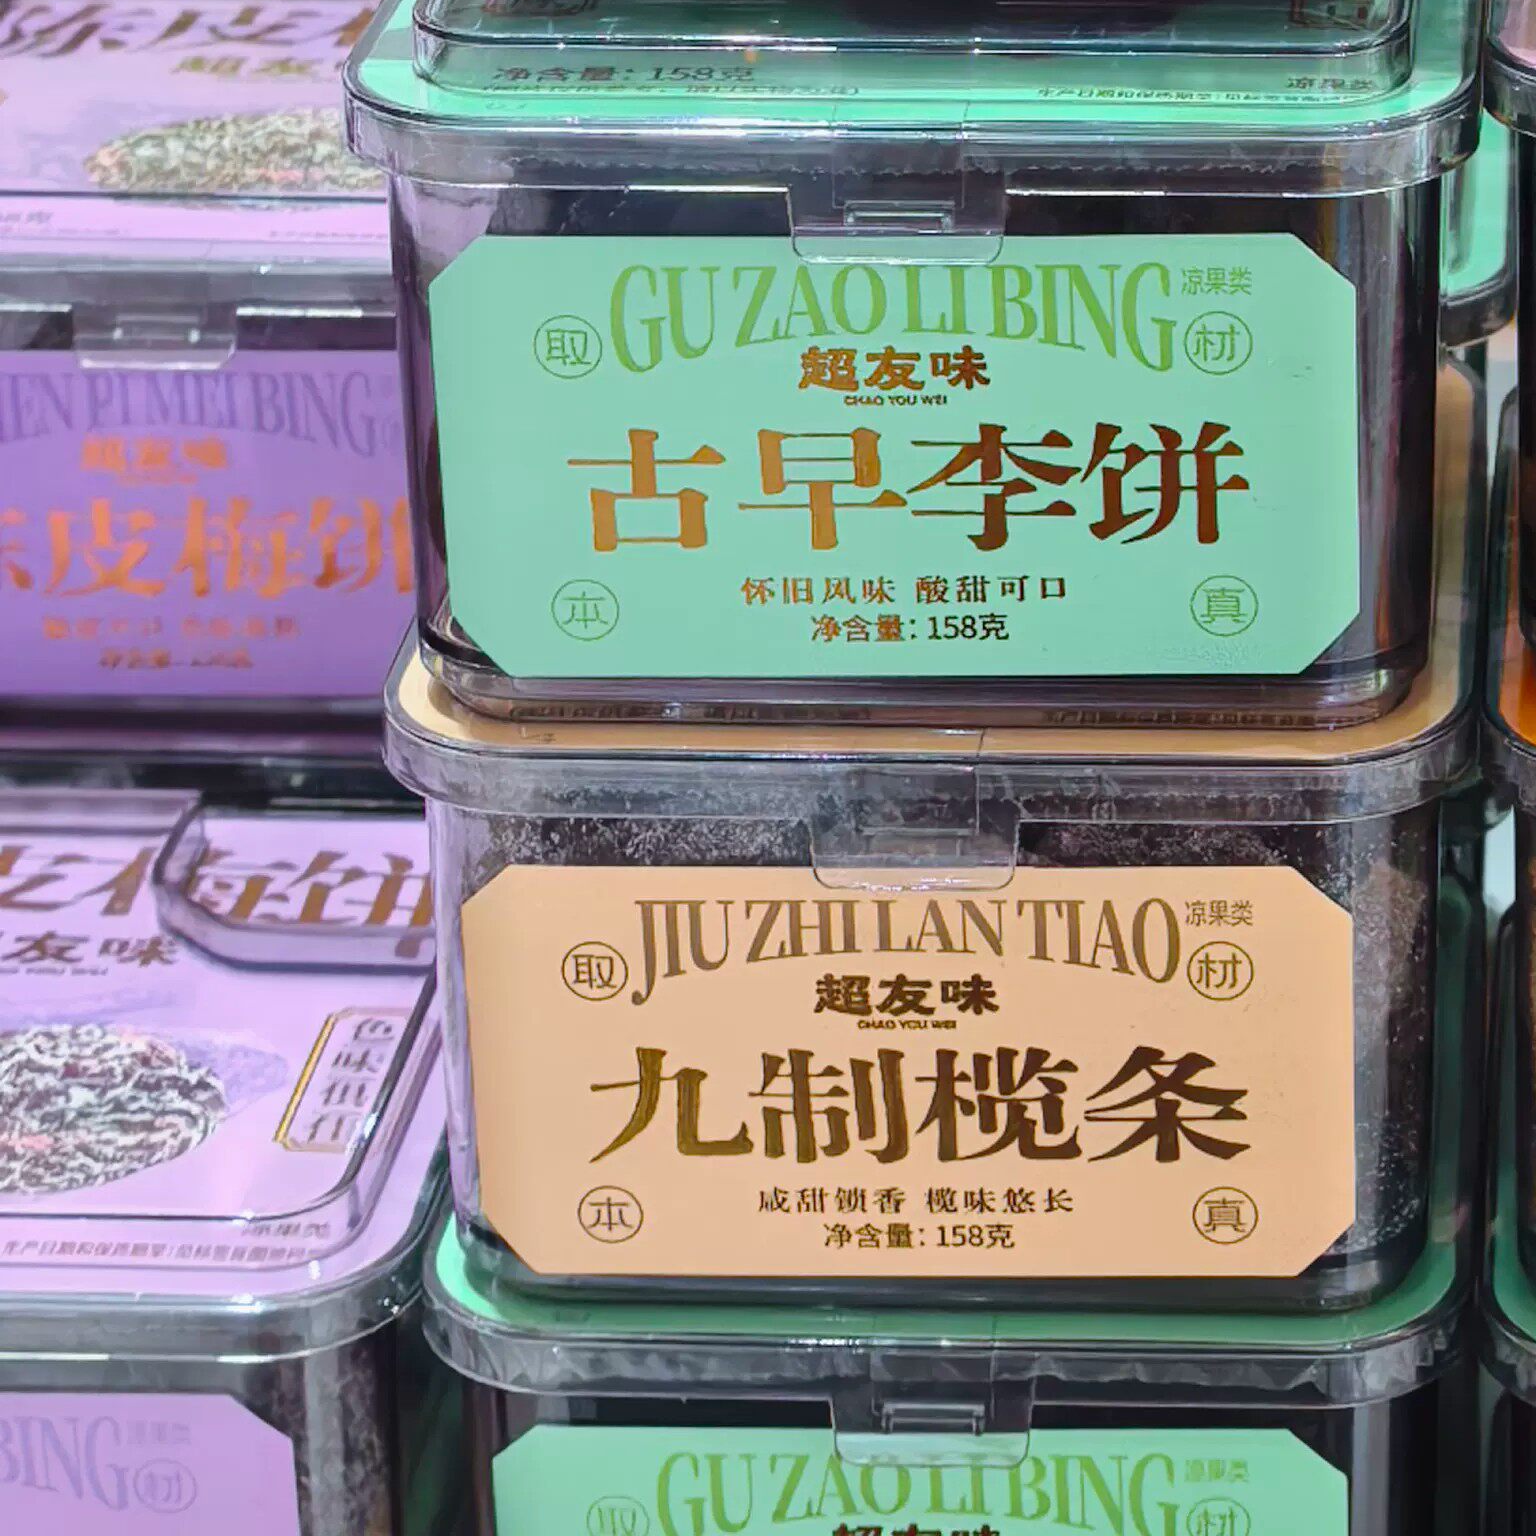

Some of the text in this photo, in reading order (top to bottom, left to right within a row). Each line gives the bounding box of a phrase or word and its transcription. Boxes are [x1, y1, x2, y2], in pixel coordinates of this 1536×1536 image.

[1179, 265, 1253, 296] 凉果类
[609, 261, 1177, 373] GU ZAO LI BING
[797, 344, 991, 392] 超友味
[888, 394, 918, 407] YOU
[920, 394, 948, 407] WEI
[566, 421, 1250, 552] 古早李饼
[740, 574, 1067, 606] 怀旧风味 酸甜可口
[810, 613, 1010, 643] 净含量：158克
[1184, 899, 1254, 927] 凉果类
[631, 897, 1182, 1006] JIU ZHI LAN TIAO
[814, 973, 1000, 1017] 超友味
[588, 1045, 1251, 1164] 九制榄条
[757, 1185, 1074, 1215] 咸甜锁香 榄味悠长
[823, 1222, 1015, 1249] 净含量：158克
